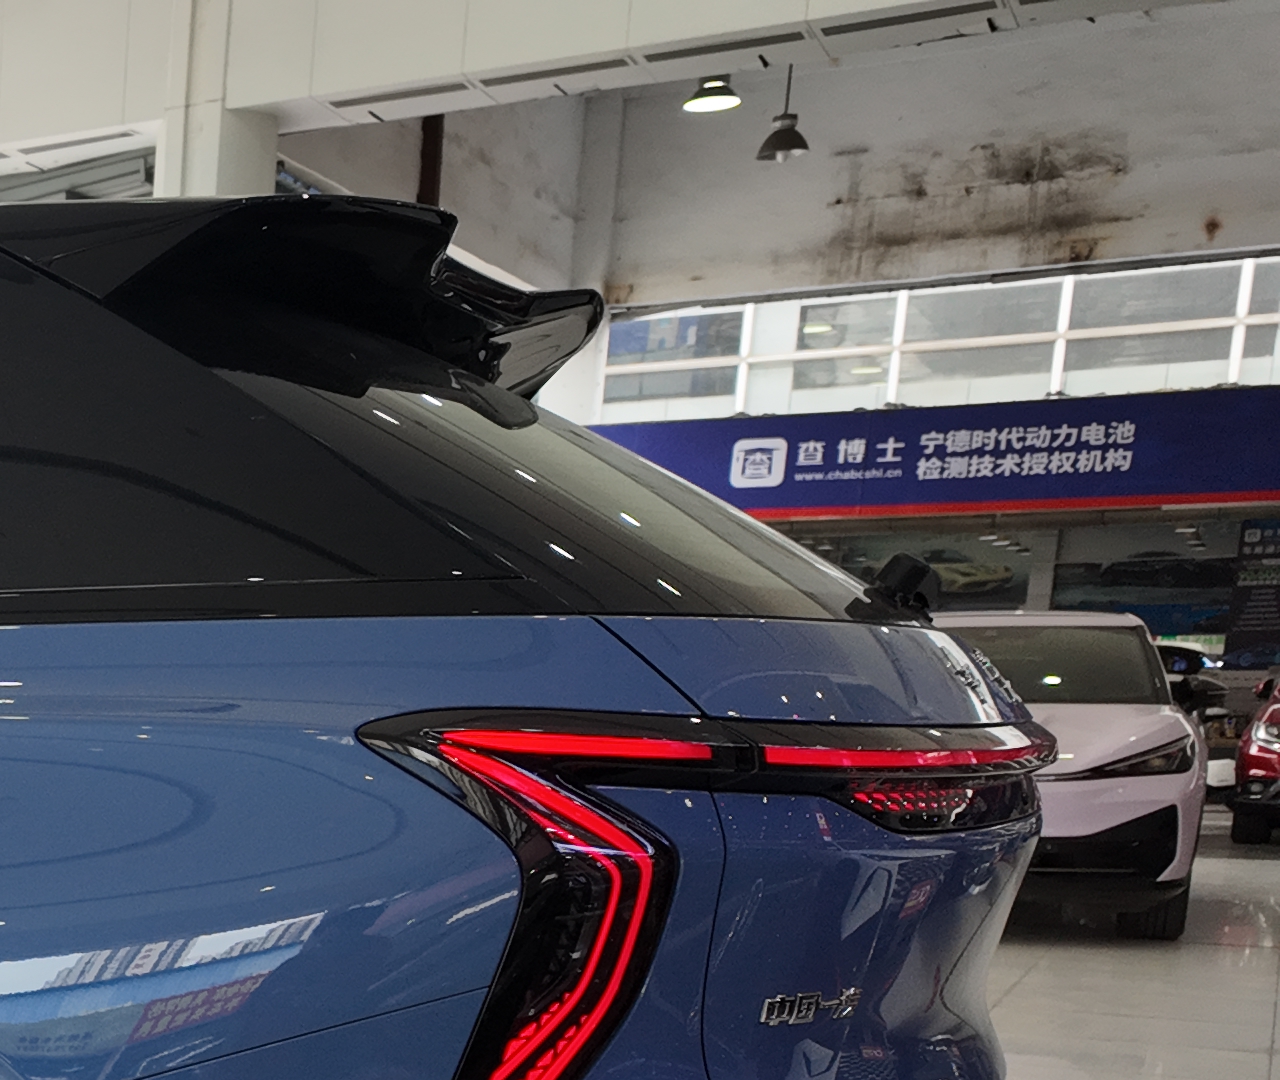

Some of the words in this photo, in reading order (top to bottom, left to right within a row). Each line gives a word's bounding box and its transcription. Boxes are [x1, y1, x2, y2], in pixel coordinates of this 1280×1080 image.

[795, 437, 906, 466] 查博士
[918, 420, 1137, 456] 宁德时代动力电池
[916, 448, 1133, 481] 检测技术授权机构
